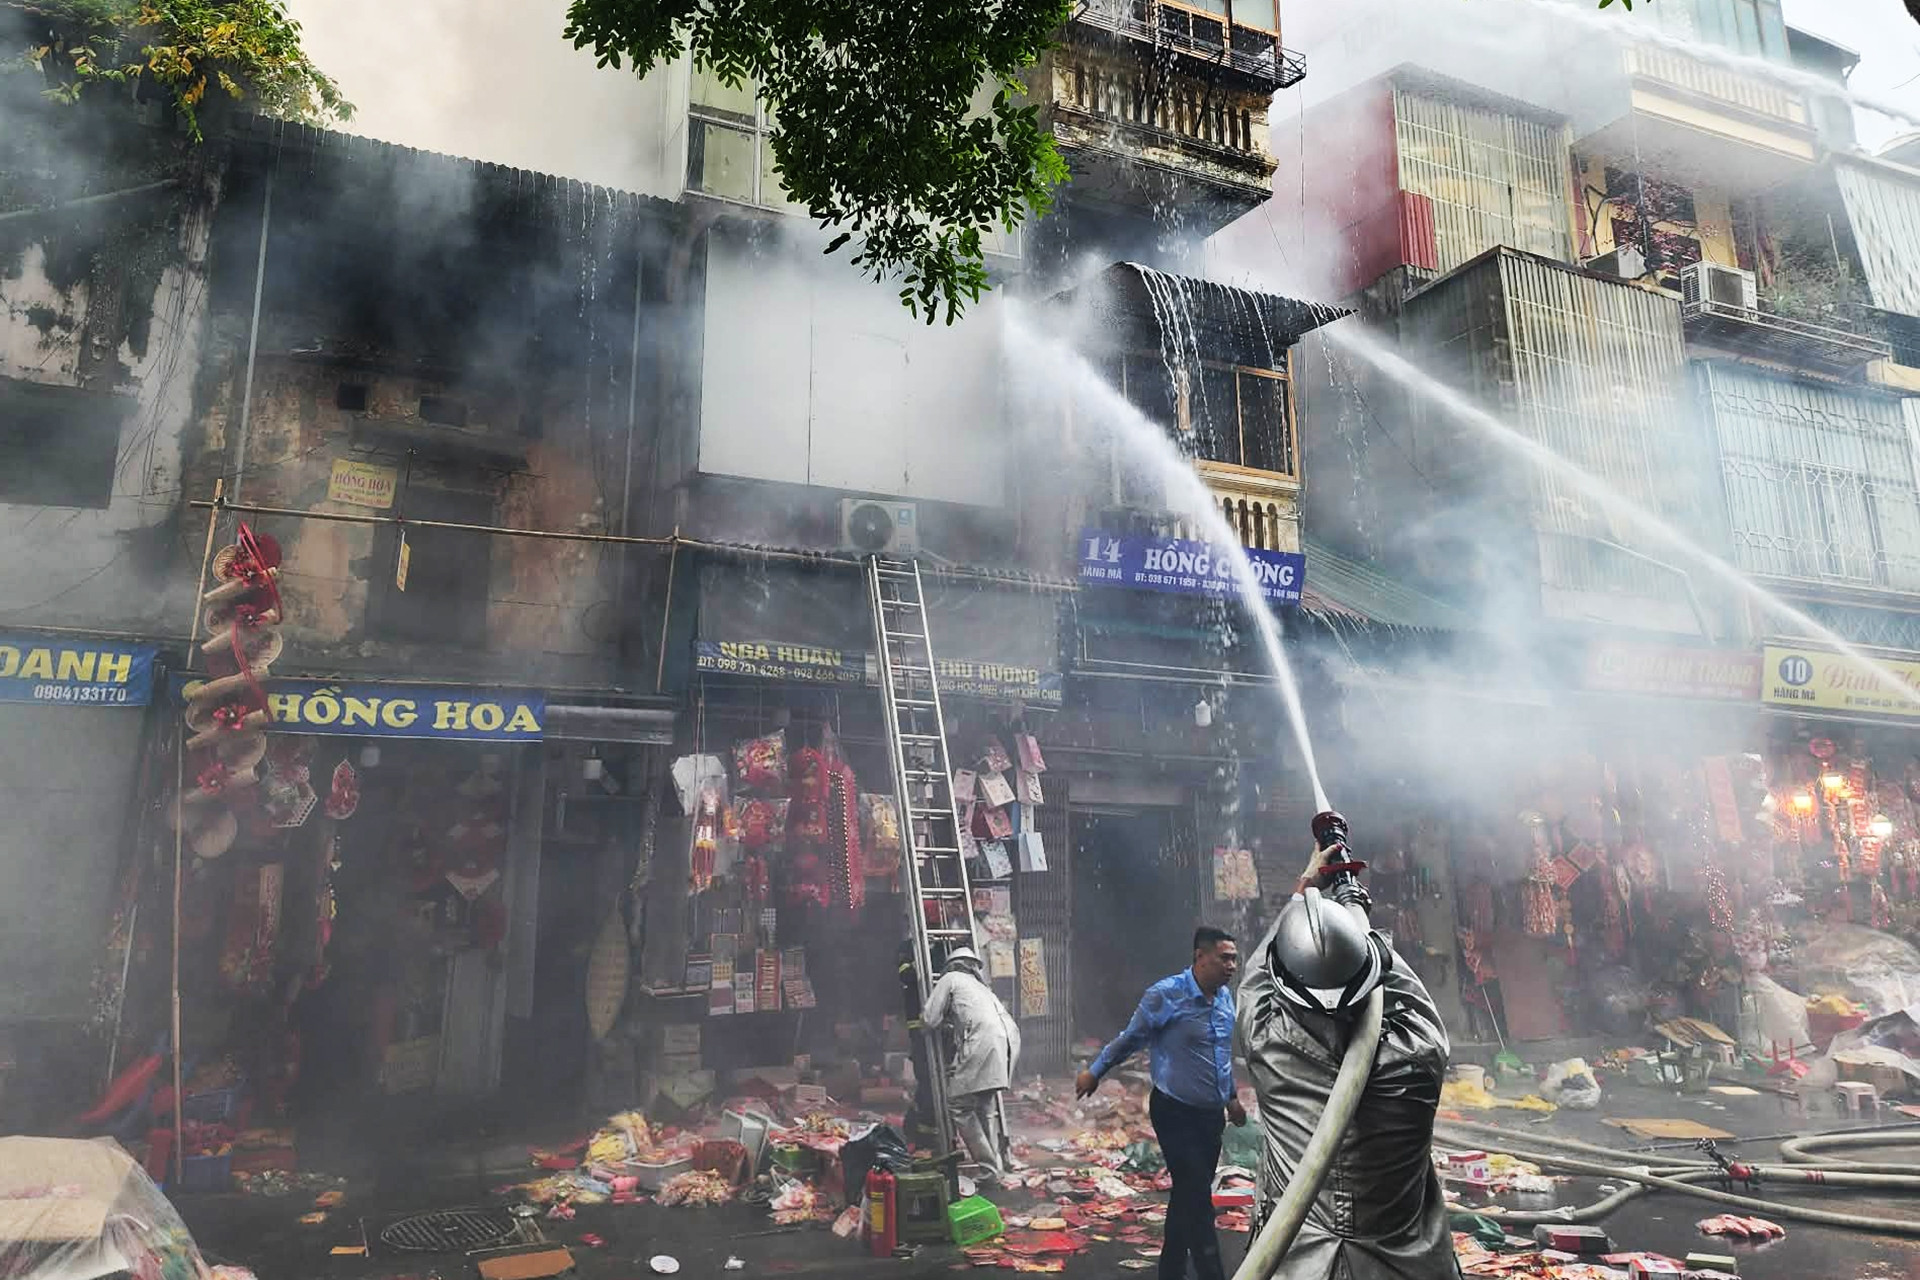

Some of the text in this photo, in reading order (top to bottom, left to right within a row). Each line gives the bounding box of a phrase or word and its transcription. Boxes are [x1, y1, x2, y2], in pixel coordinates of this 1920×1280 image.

[1084, 537, 1123, 562] 14
[1144, 539, 1294, 586] HỒNG CỜNG
[719, 641, 770, 660] NGA
[1784, 659, 1807, 682] 10
[34, 684, 127, 702] 0904133170
[267, 685, 542, 733] HỒNG HOA
